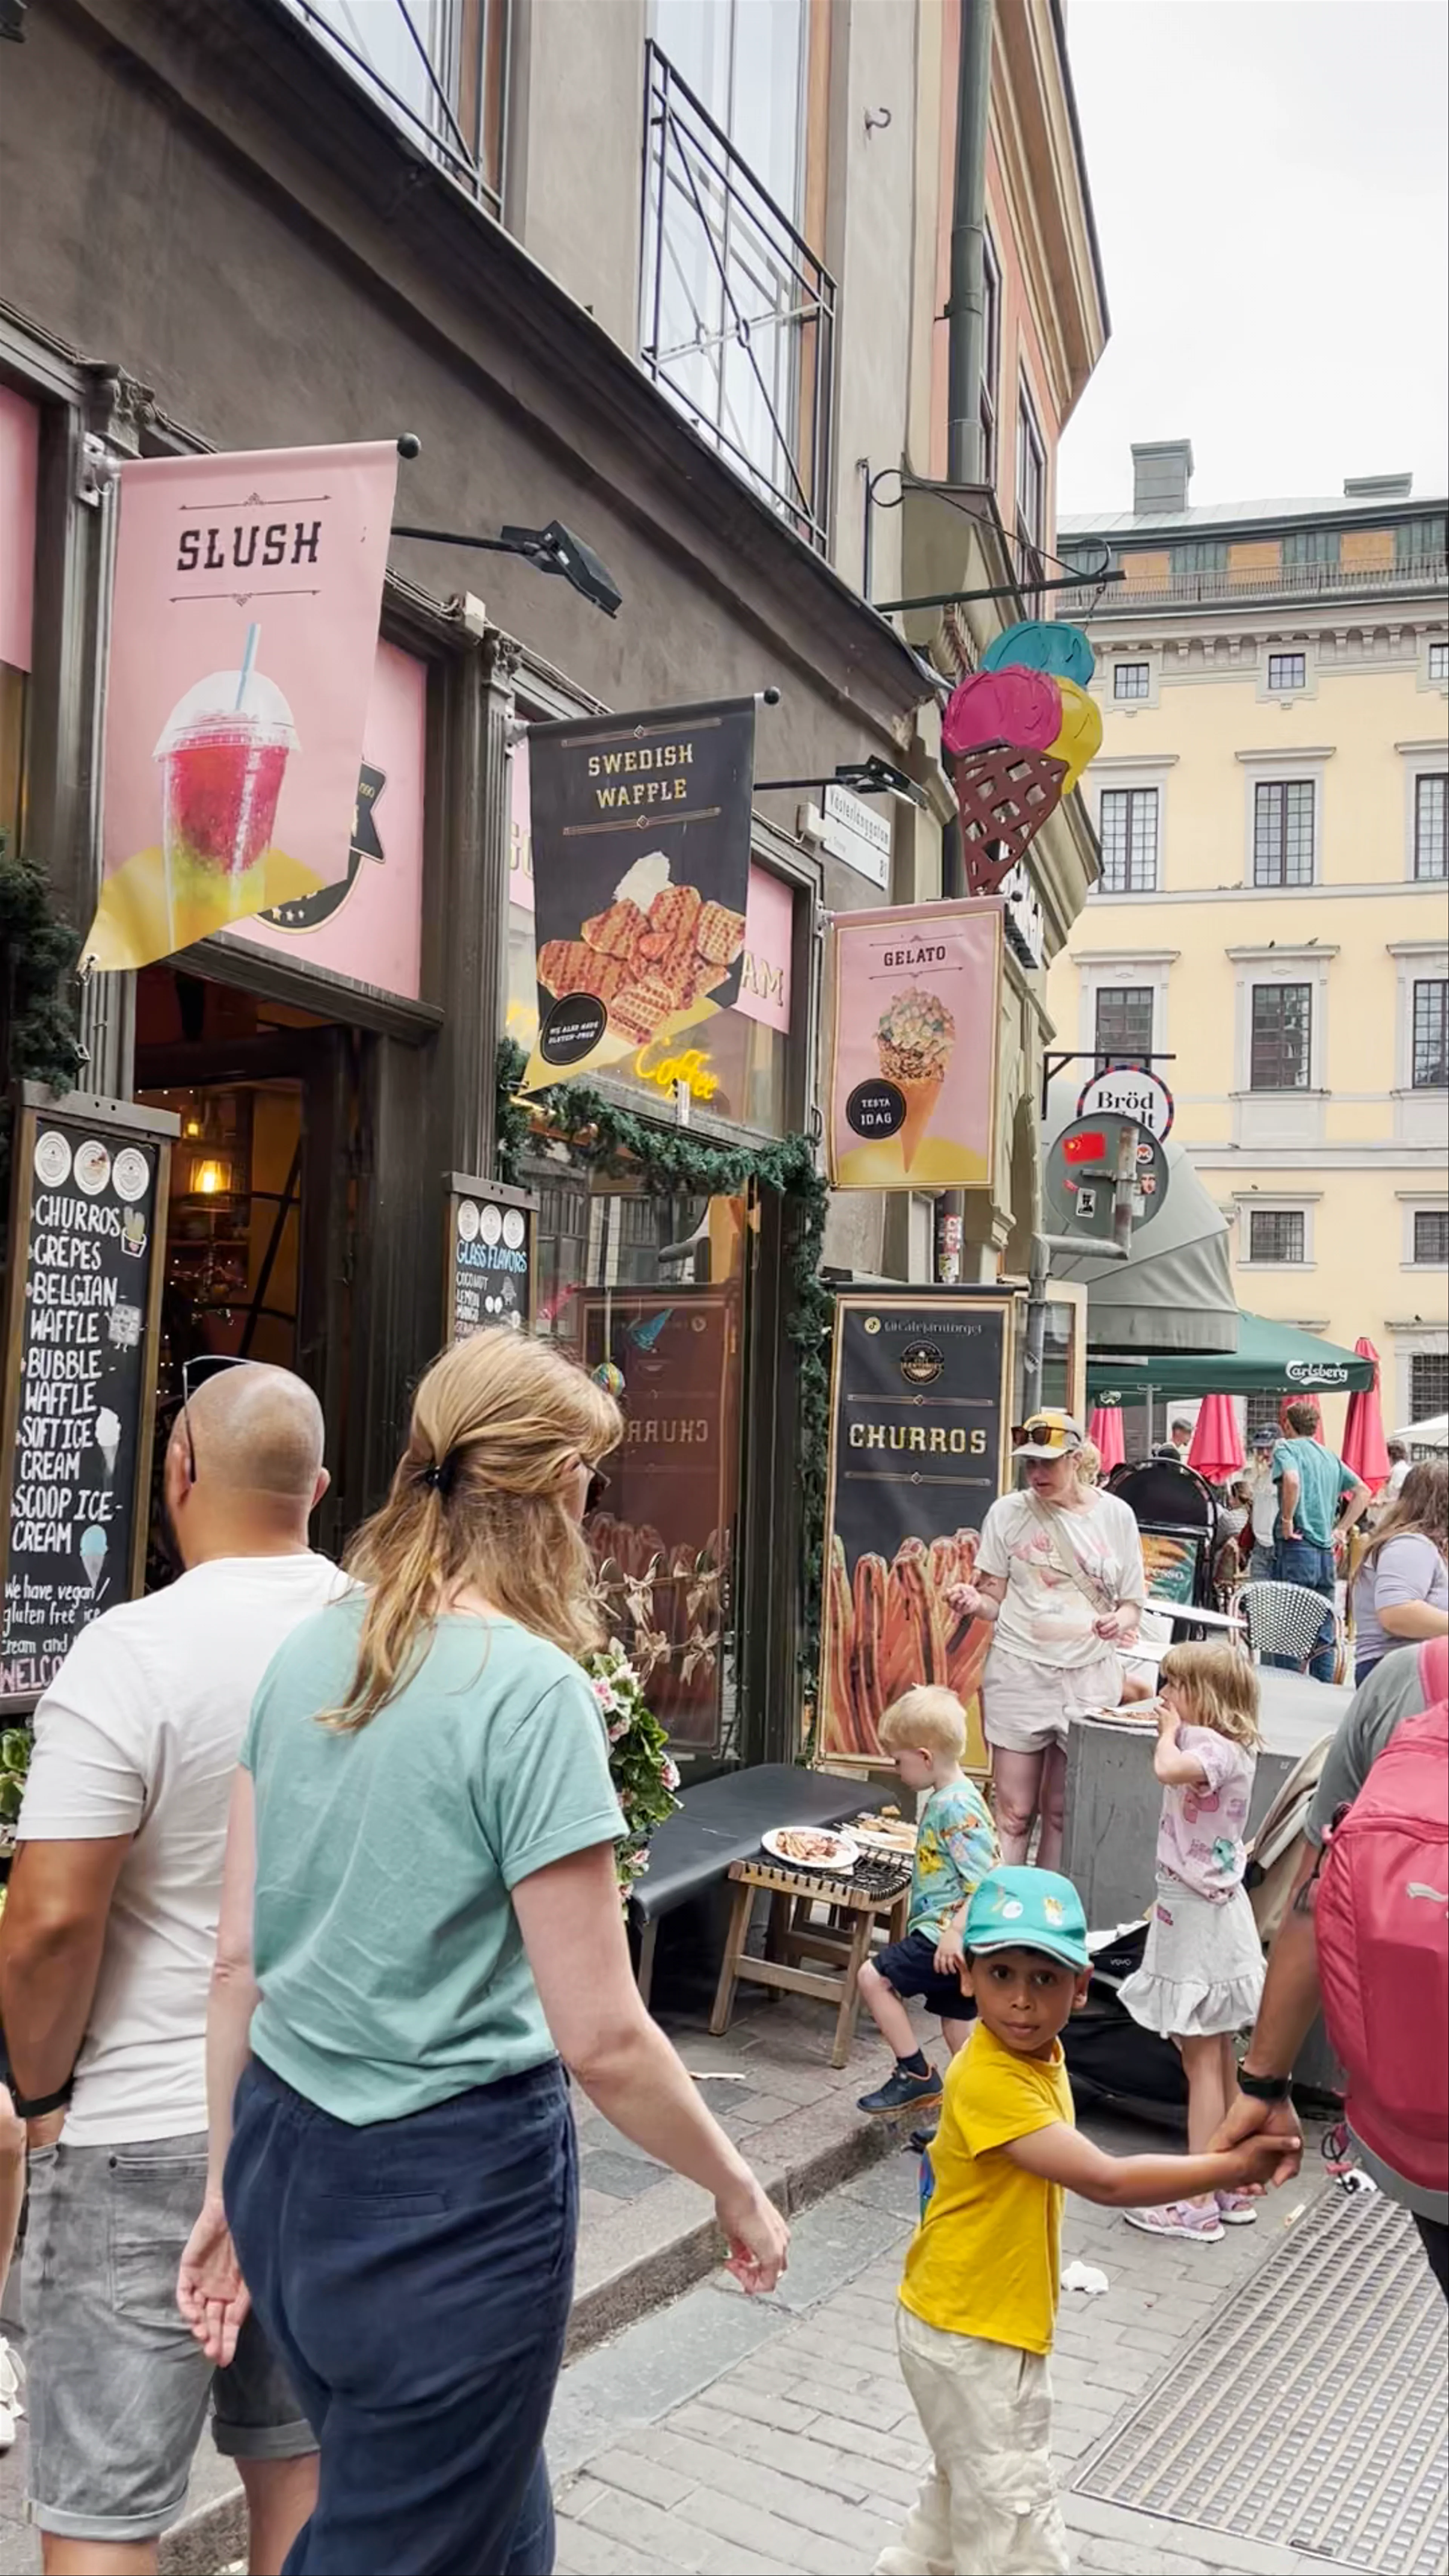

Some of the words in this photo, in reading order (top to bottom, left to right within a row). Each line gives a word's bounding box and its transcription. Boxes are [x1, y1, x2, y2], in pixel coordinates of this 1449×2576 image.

[177, 521, 321, 571] SLUSH
[588, 743, 694, 777] SWEDISH
[596, 778, 687, 809] WAFFLE
[884, 946, 946, 967] GELATO
[861, 1099, 891, 1109] TESTA
[1097, 1091, 1154, 1109] Bröd
[861, 1113, 892, 1126] IDAG
[35, 1195, 121, 1237] CHURROS
[457, 1240, 487, 1268] GLASS
[487, 1244, 527, 1273] FLAVORS
[30, 1308, 100, 1343] WAFFLE
[1286, 1360, 1348, 1386] Carlsberg
[25, 1381, 97, 1415] WAFFLE
[22, 1416, 61, 1448] SOFT
[62, 1418, 94, 1450] ICE
[849, 1424, 986, 1454] CHURROS
[20, 1451, 80, 1481] CREAM
[14, 1484, 72, 1519] SCOOP
[12, 1522, 72, 1554] CREAM
[5, 1574, 21, 1600] We
[23, 1573, 52, 1600] have
[2, 1601, 45, 1637] gluten
[49, 1601, 75, 1625] free
[83, 1607, 101, 1622] ice
[43, 1633, 68, 1653] and
